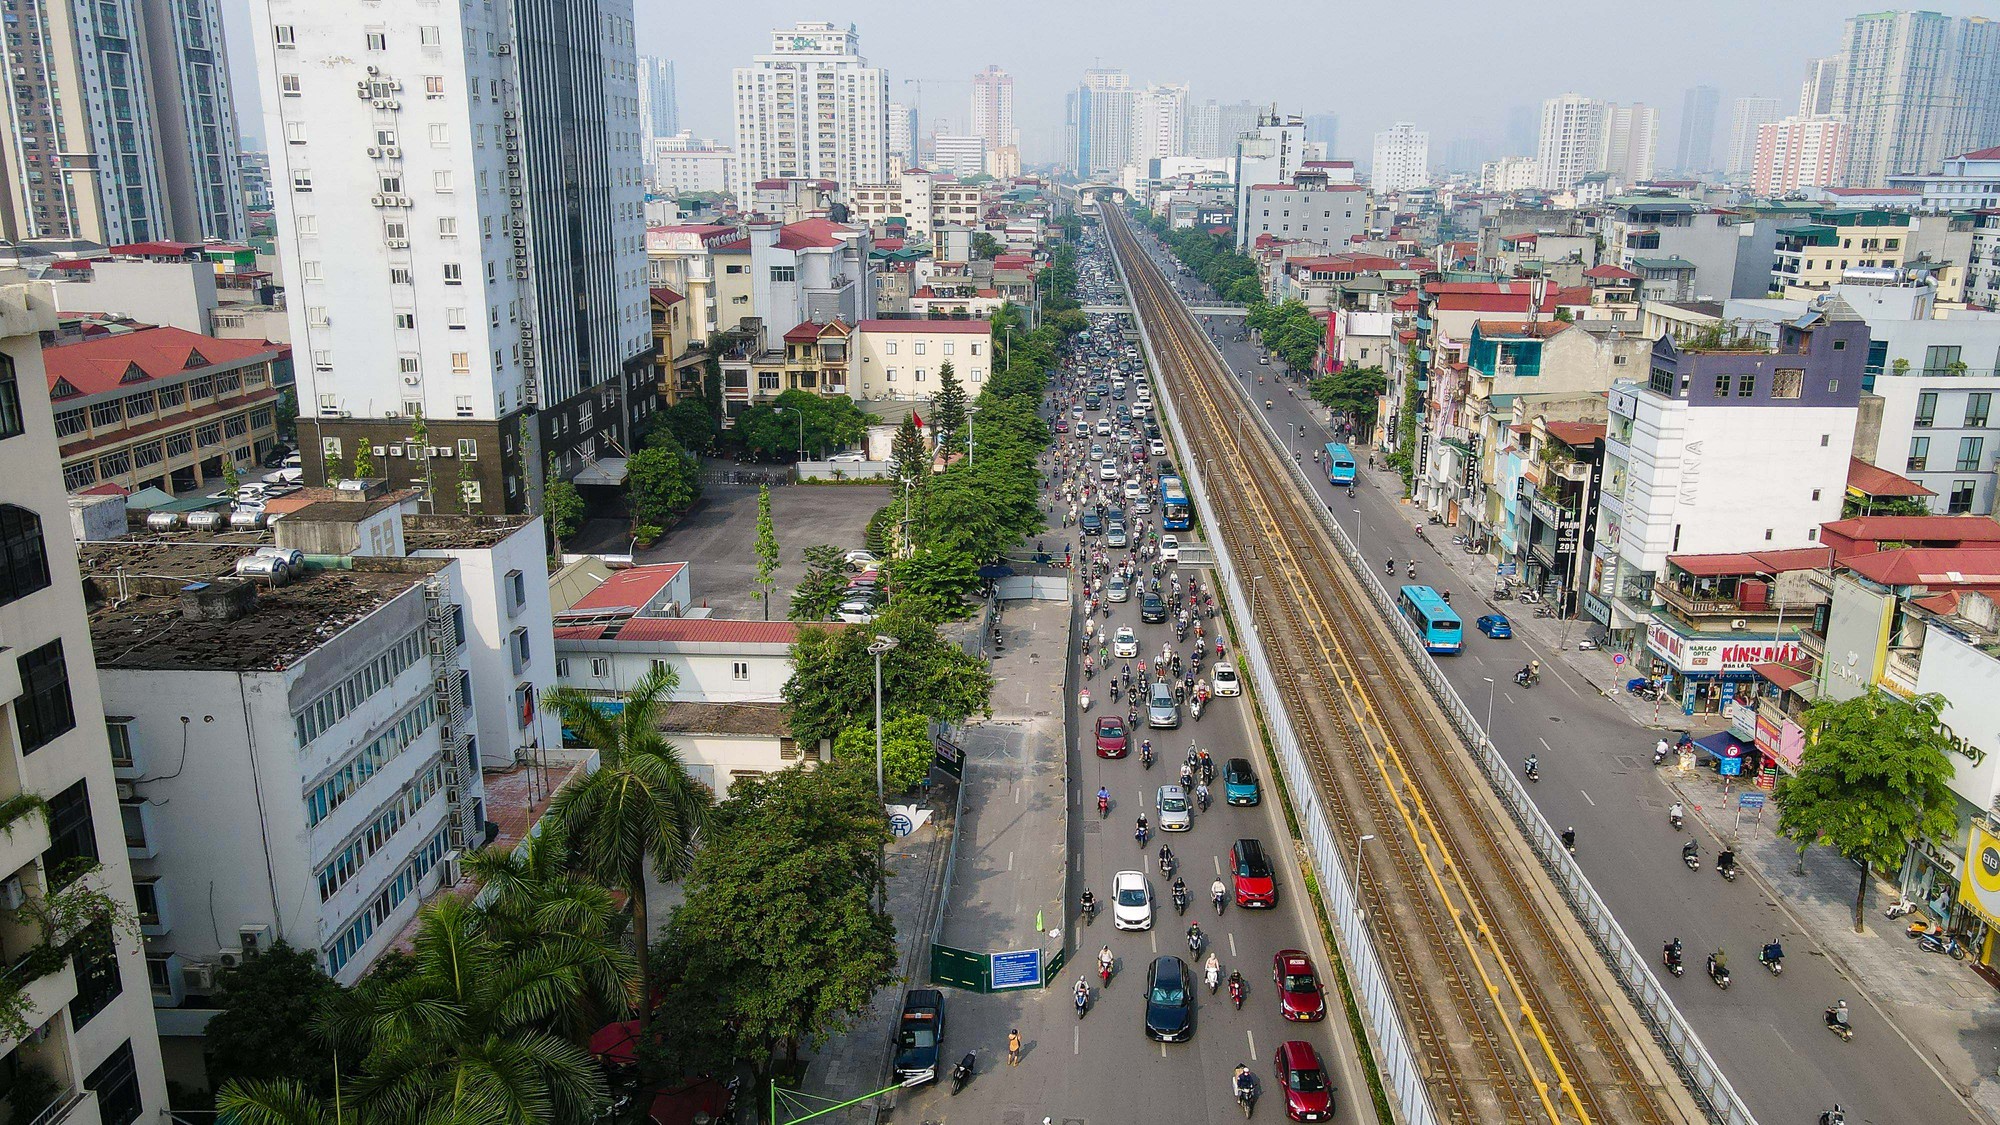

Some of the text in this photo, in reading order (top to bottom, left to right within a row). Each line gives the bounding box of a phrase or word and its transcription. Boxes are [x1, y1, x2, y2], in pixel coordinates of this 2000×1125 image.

[1679, 440, 1704, 506] MINA
[1586, 458, 1601, 532] LEIKA
[1602, 555, 1618, 594] MINA
[1721, 644, 1762, 663] KÍNH
[1939, 721, 1988, 769] Daisy
[1926, 842, 1956, 875] Daisy
